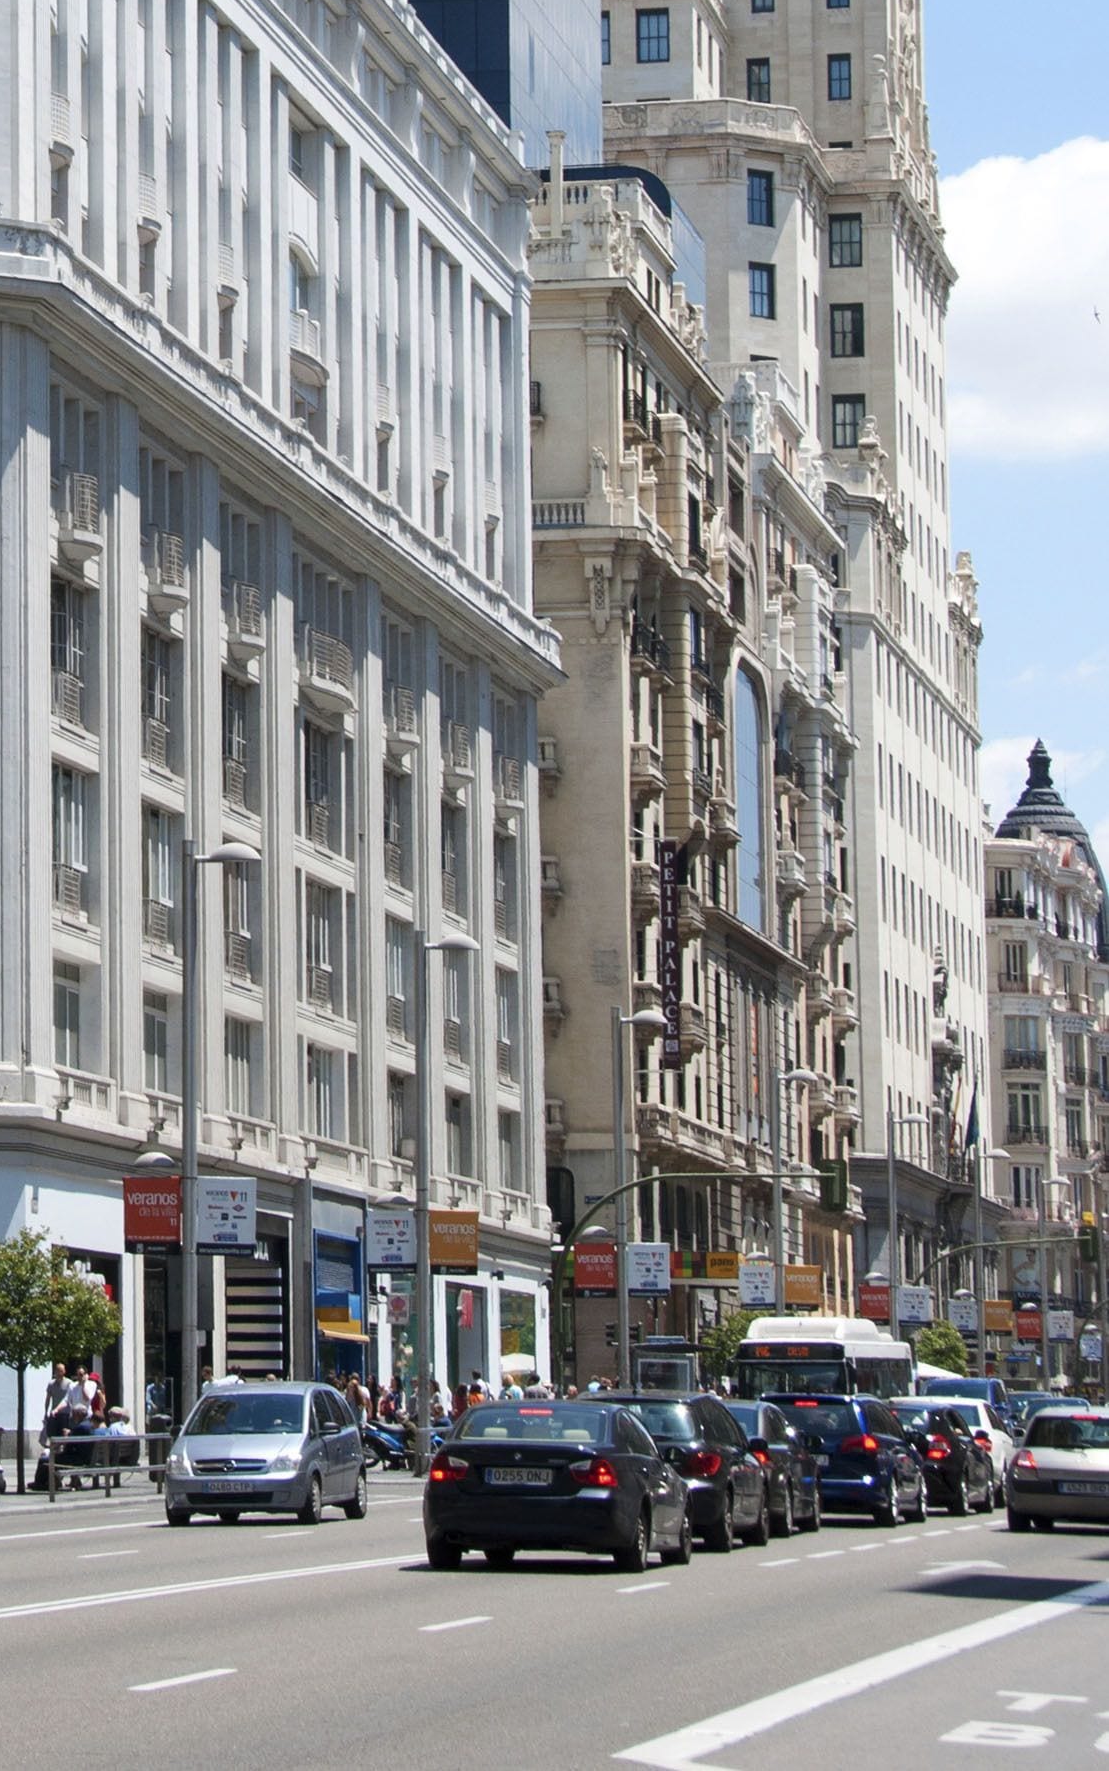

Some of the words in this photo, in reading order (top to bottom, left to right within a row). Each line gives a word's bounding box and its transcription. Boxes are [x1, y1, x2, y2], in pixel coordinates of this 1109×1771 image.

[664, 851, 676, 929] PETIT
[664, 941, 678, 1035] PALACE
[126, 1192, 178, 1205] veranos
[432, 1223, 476, 1235] veranos
[577, 1254, 613, 1264] veranos
